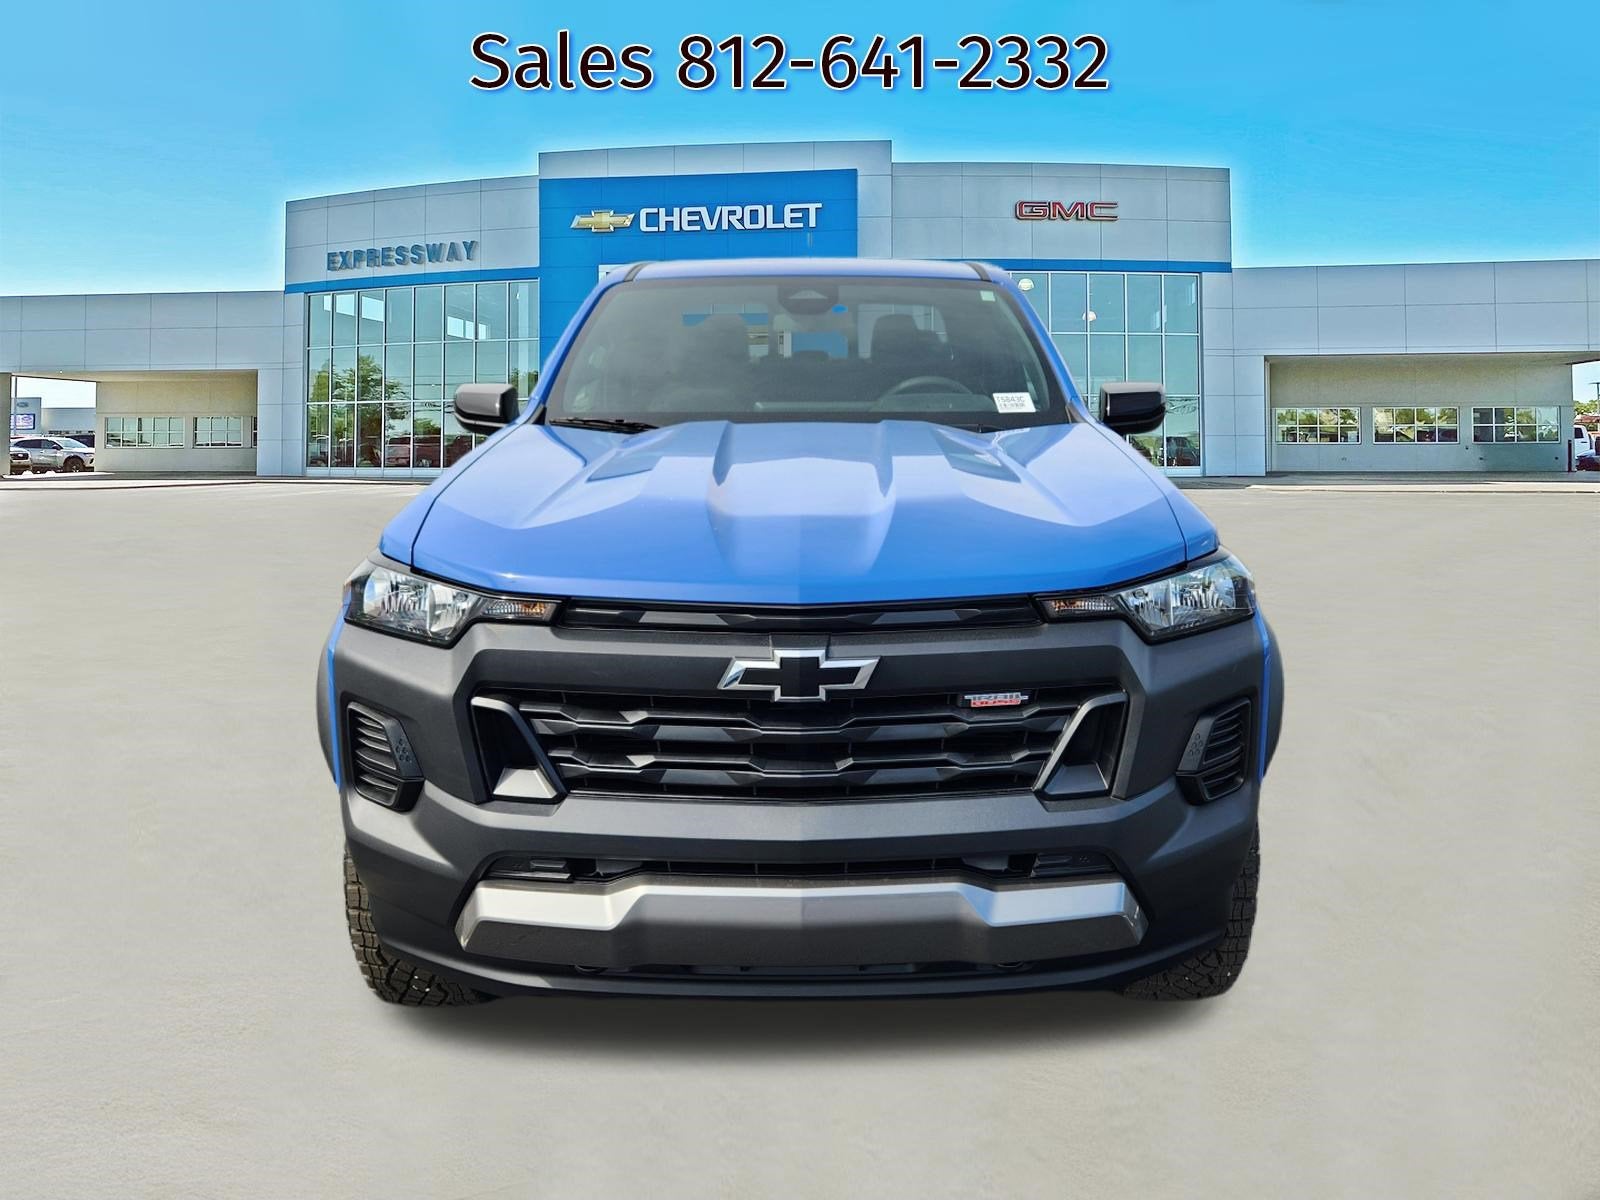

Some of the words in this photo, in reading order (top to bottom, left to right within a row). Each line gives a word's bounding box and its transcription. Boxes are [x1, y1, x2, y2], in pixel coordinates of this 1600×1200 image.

[639, 202, 823, 232] CHEVROLET
[1014, 200, 1119, 221] GMC
[326, 240, 480, 272] EXPRESSWAY
